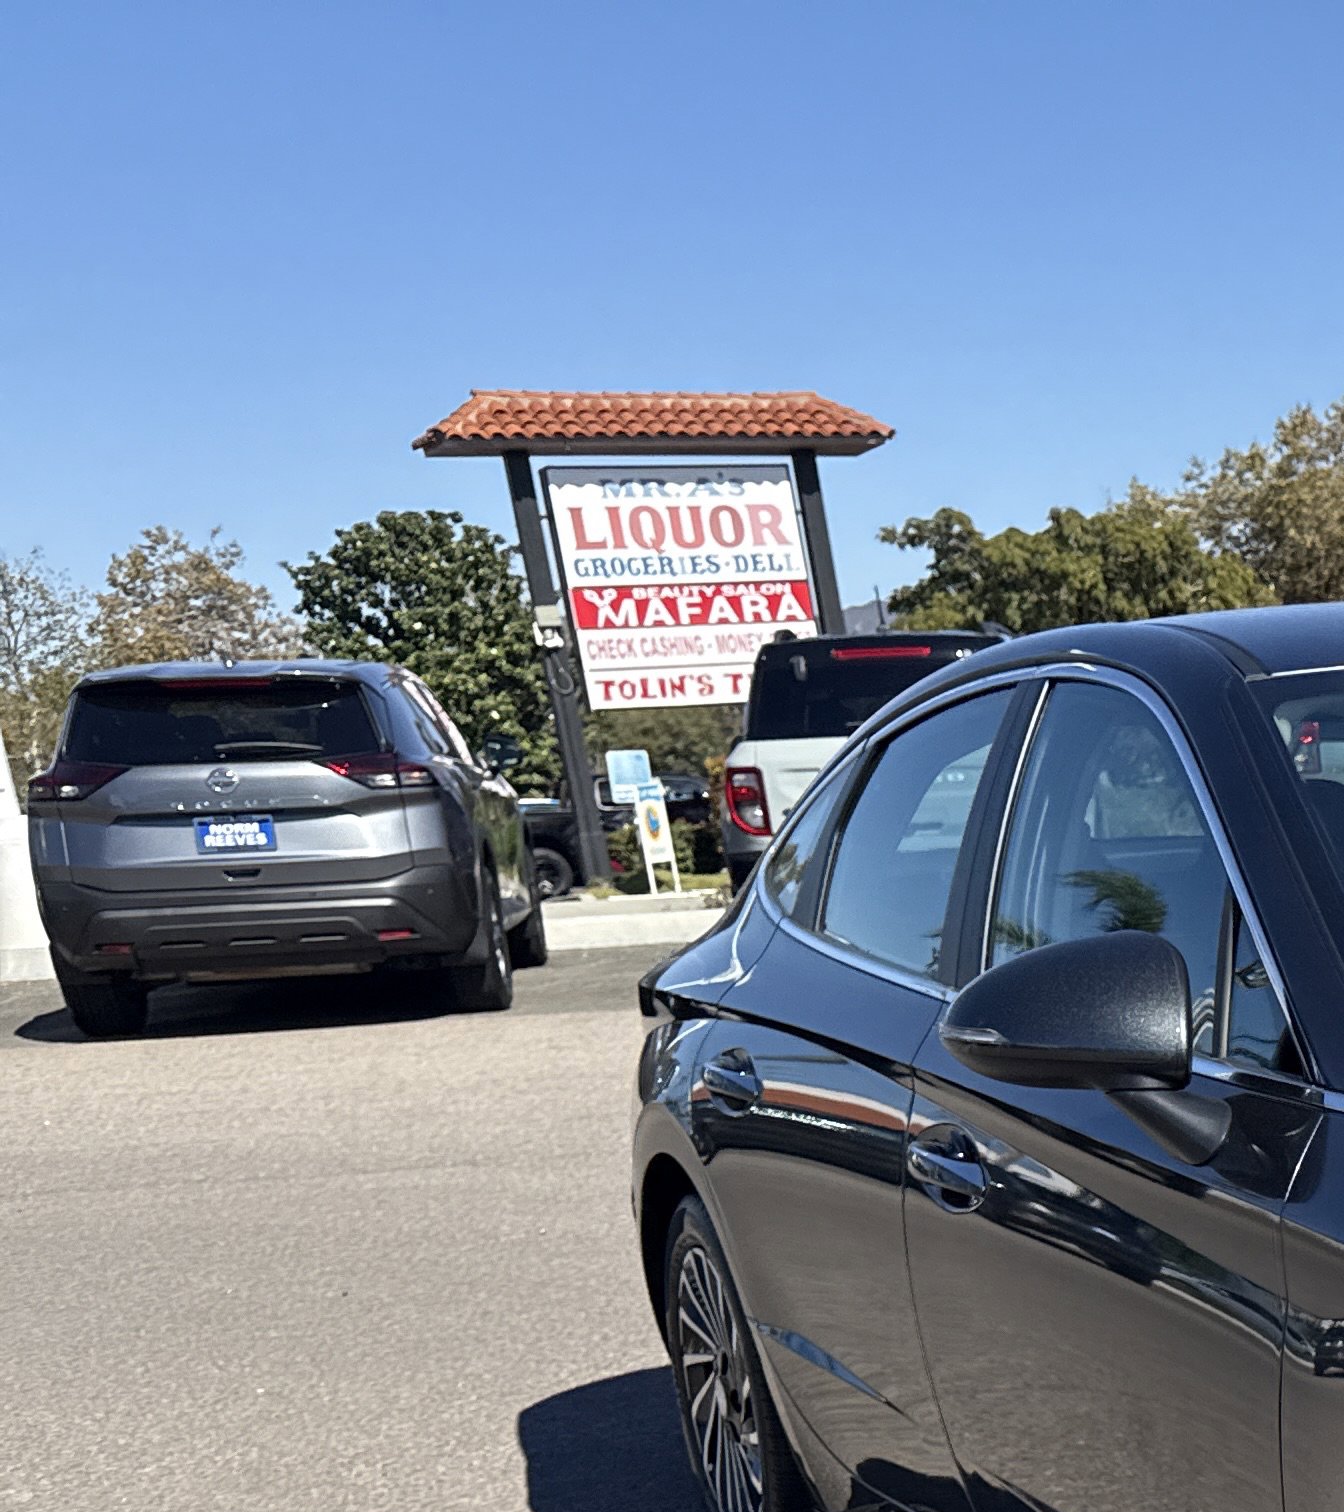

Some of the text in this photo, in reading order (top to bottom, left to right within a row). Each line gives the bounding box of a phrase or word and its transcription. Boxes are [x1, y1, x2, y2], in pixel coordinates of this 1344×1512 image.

[567, 503, 794, 554] LIQUOR
[631, 582, 792, 601] BEAUTY SALON
[595, 592, 808, 628] MAFARA
[586, 636, 638, 661] CHECK
[639, 634, 704, 660] CASHING
[594, 673, 715, 701] TOLIN'S
[203, 832, 268, 847] REEVES
[208, 822, 260, 836] NORM
